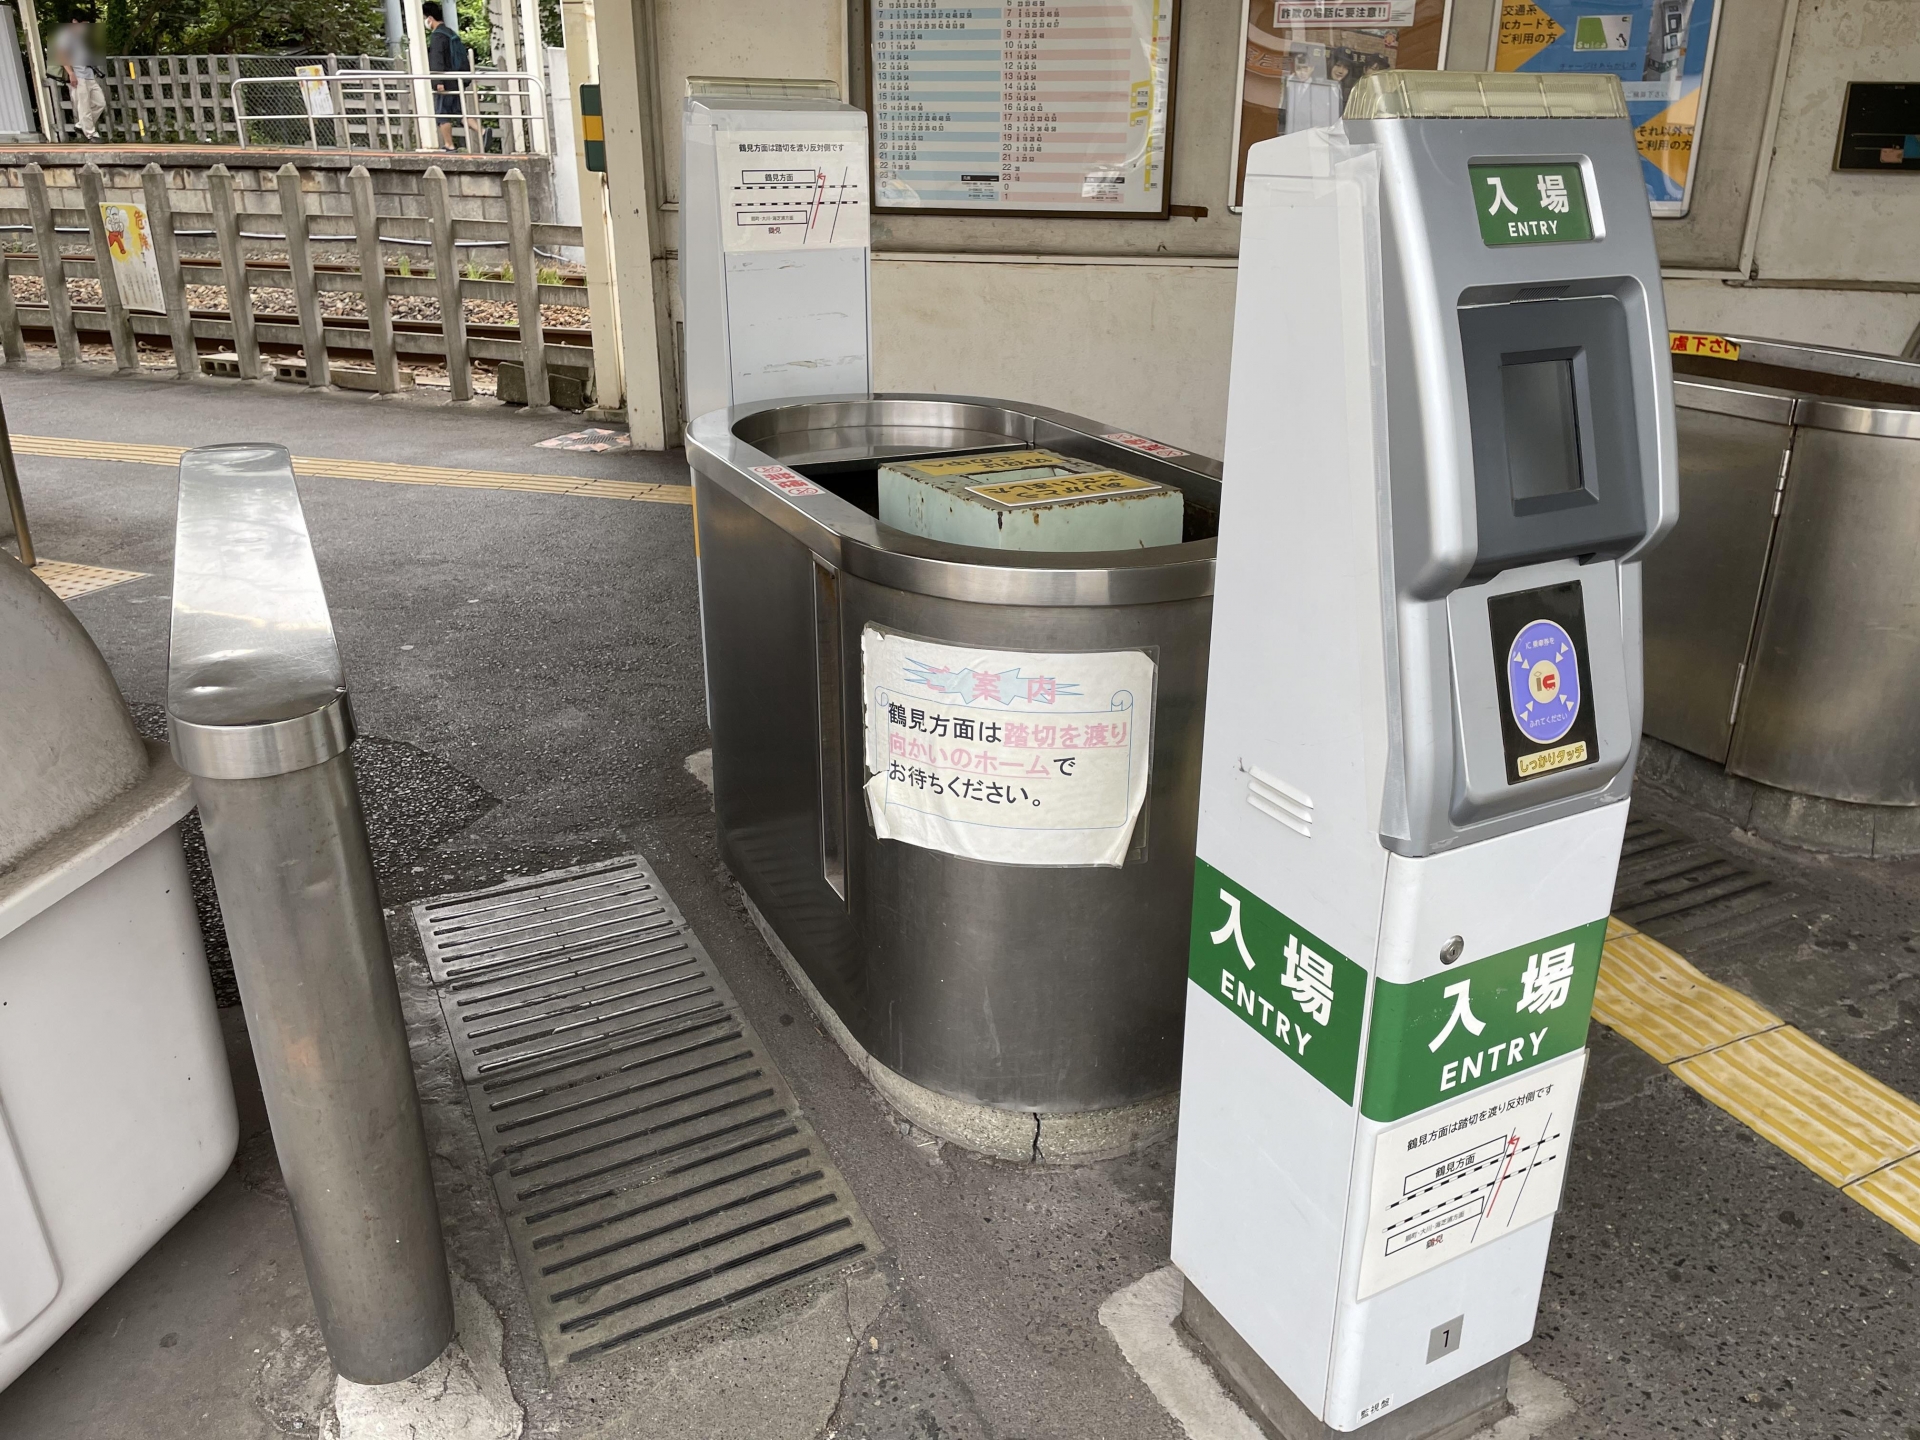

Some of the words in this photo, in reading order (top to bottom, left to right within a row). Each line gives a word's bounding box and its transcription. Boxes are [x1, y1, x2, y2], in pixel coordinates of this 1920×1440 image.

[1502, 4, 1538, 17] 交通系
[1502, 18, 1556, 30] ICカードを
[1500, 32, 1557, 44] ご利用の方
[1637, 140, 1692, 151] ご利用の方
[1638, 126, 1695, 137] それ以外で
[738, 144, 844, 152] 鶴見方面は踏切を渡り反対側です
[764, 174, 794, 182] 鶴見方面
[1486, 174, 1570, 216] 入場
[1508, 220, 1558, 237] ENTRY
[926, 665, 1056, 704] ご案内
[888, 702, 1128, 749] 鶴見方面は踏切を渡り
[1529, 713, 1568, 728] ふれてください
[889, 732, 1076, 777] 向かいのホームで
[1519, 744, 1585, 773] しっかりタッチ
[889, 760, 1041, 807] お待ちください。
[1210, 887, 1334, 1027] 入場
[1428, 942, 1576, 1054] 入場
[1220, 968, 1312, 1057] ENTRY
[1439, 1026, 1550, 1092] ENTRY
[1406, 1083, 1555, 1152] 鶴見方面は踏切を渡り反対側です
[1435, 1152, 1476, 1179] 鶴見方面
[1442, 1329, 1450, 1348] 1
